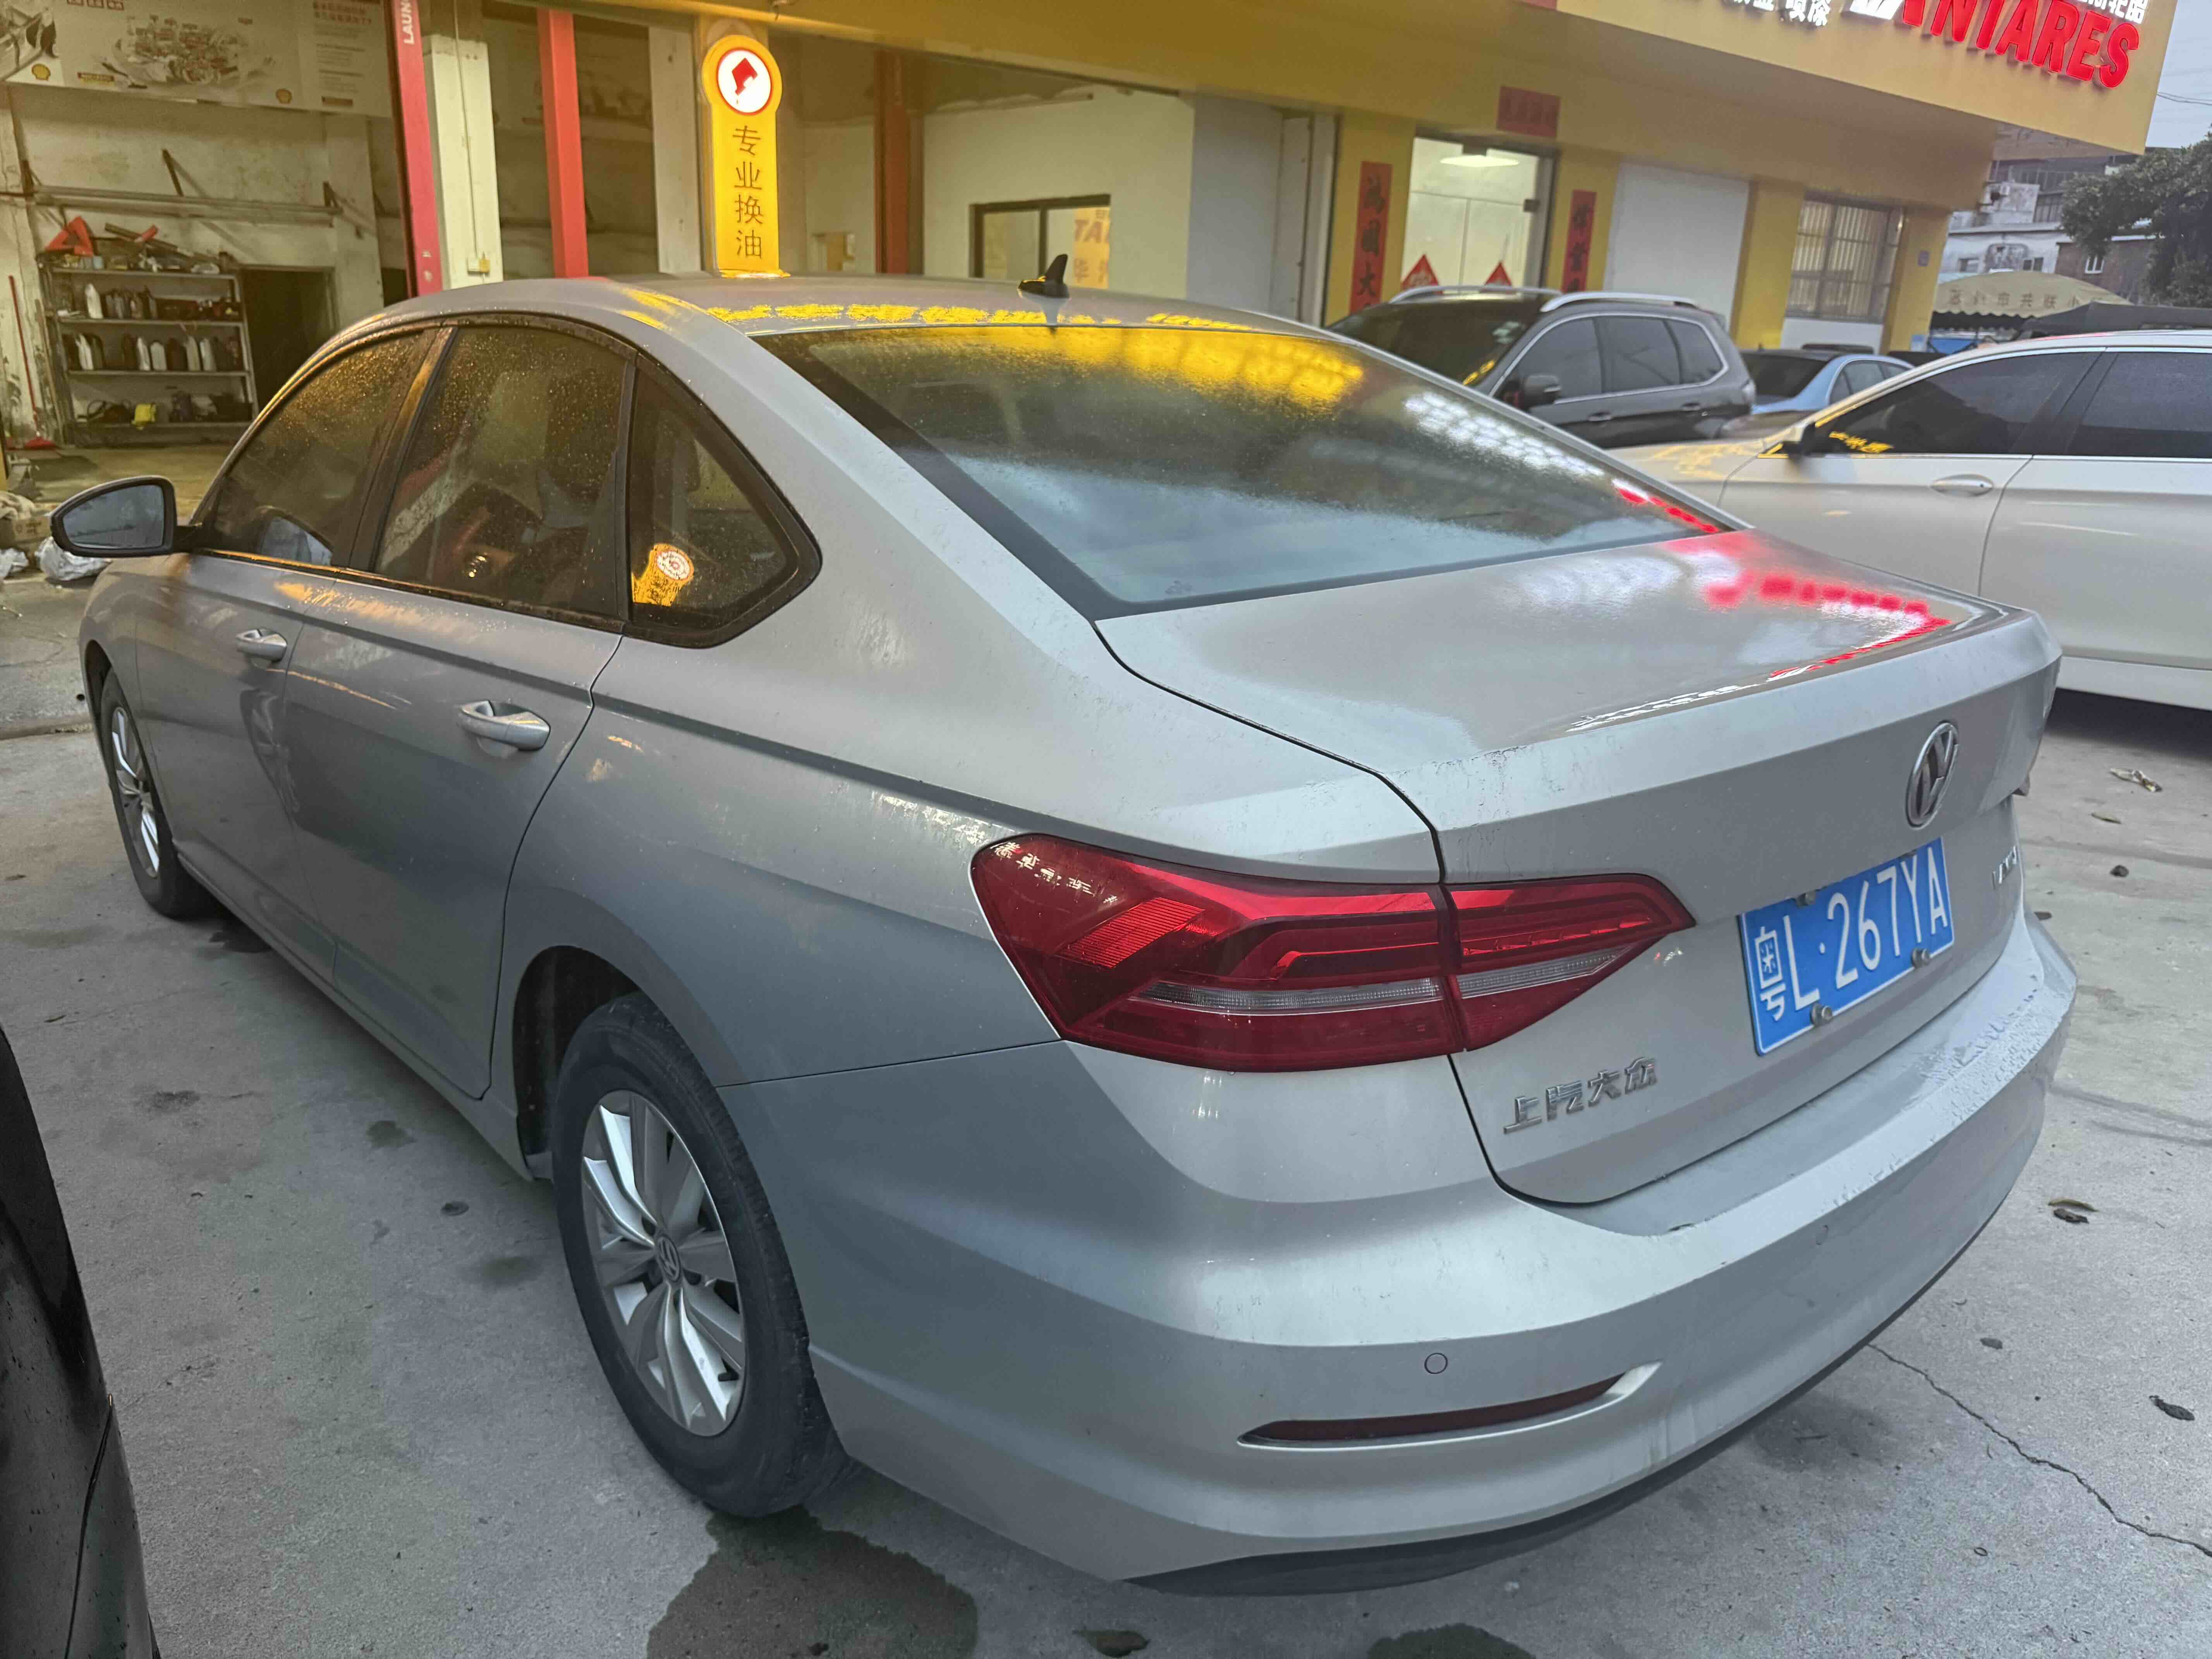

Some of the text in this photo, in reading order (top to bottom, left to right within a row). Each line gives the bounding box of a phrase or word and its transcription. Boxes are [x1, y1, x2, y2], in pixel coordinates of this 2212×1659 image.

[400, 0, 414, 45] LAUN
[732, 125, 763, 259] 专业换油
[1503, 1056, 1657, 1135] 上汽大众
